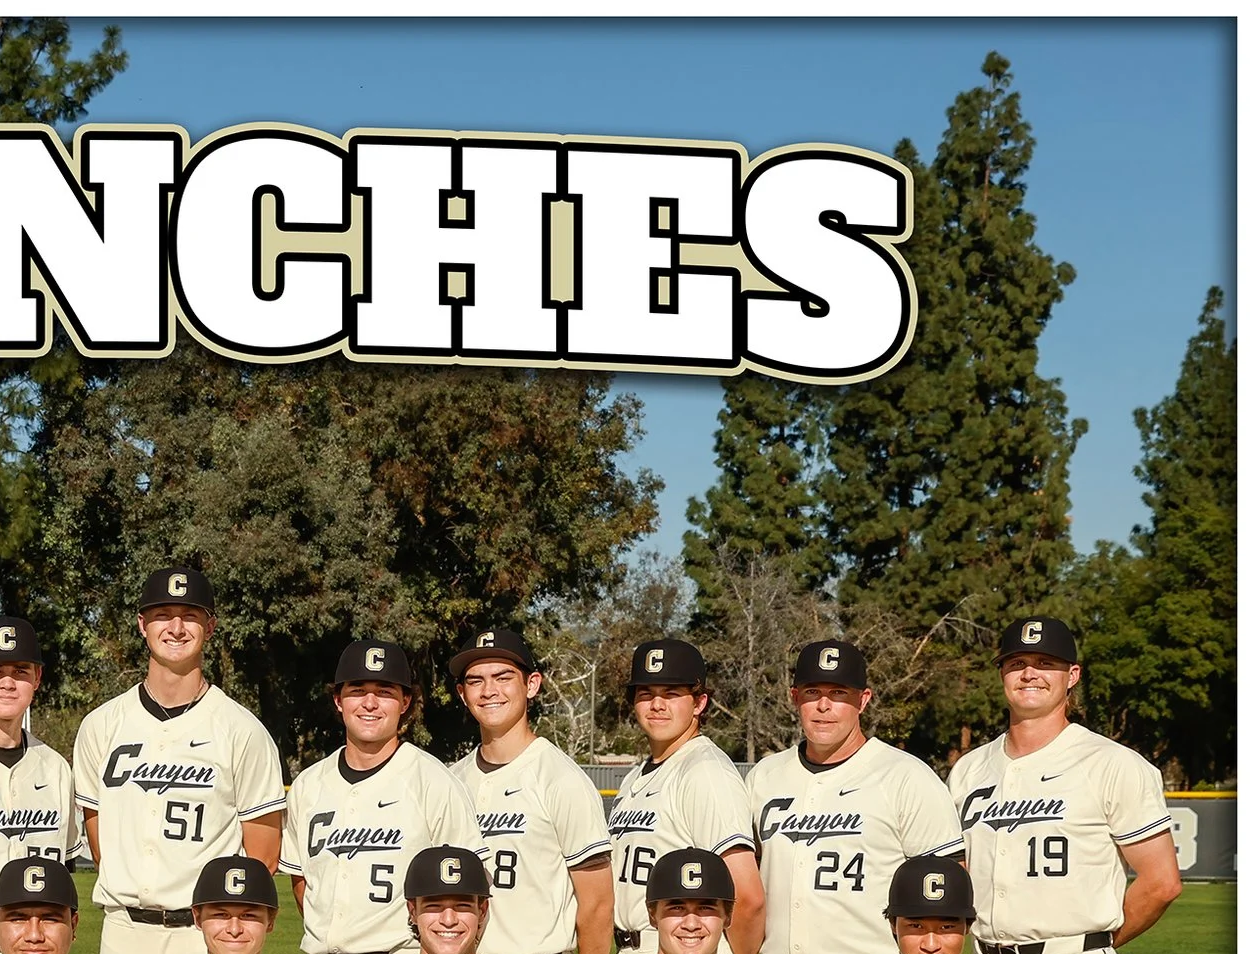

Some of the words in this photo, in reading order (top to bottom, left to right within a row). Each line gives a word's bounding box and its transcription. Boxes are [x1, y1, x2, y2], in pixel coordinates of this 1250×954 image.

[167, 574, 187, 597] C
[476, 632, 494, 648] C
[1021, 621, 1042, 644] C
[365, 648, 384, 671] C
[645, 650, 663, 672] C
[819, 648, 839, 670] C
[103, 744, 215, 795] Canyon
[164, 801, 204, 842] 51
[760, 798, 863, 847] Canyon
[962, 785, 1066, 832] Canyon
[308, 812, 402, 859] Canyon
[440, 857, 461, 884] C
[493, 849, 517, 889] 8
[619, 845, 655, 886] 16
[1027, 836, 1068, 877] 19
[23, 866, 45, 892] C
[224, 868, 245, 895] C
[369, 865, 394, 903] 5
[681, 862, 702, 890] C
[814, 851, 864, 891] 24
[923, 873, 944, 900] C
